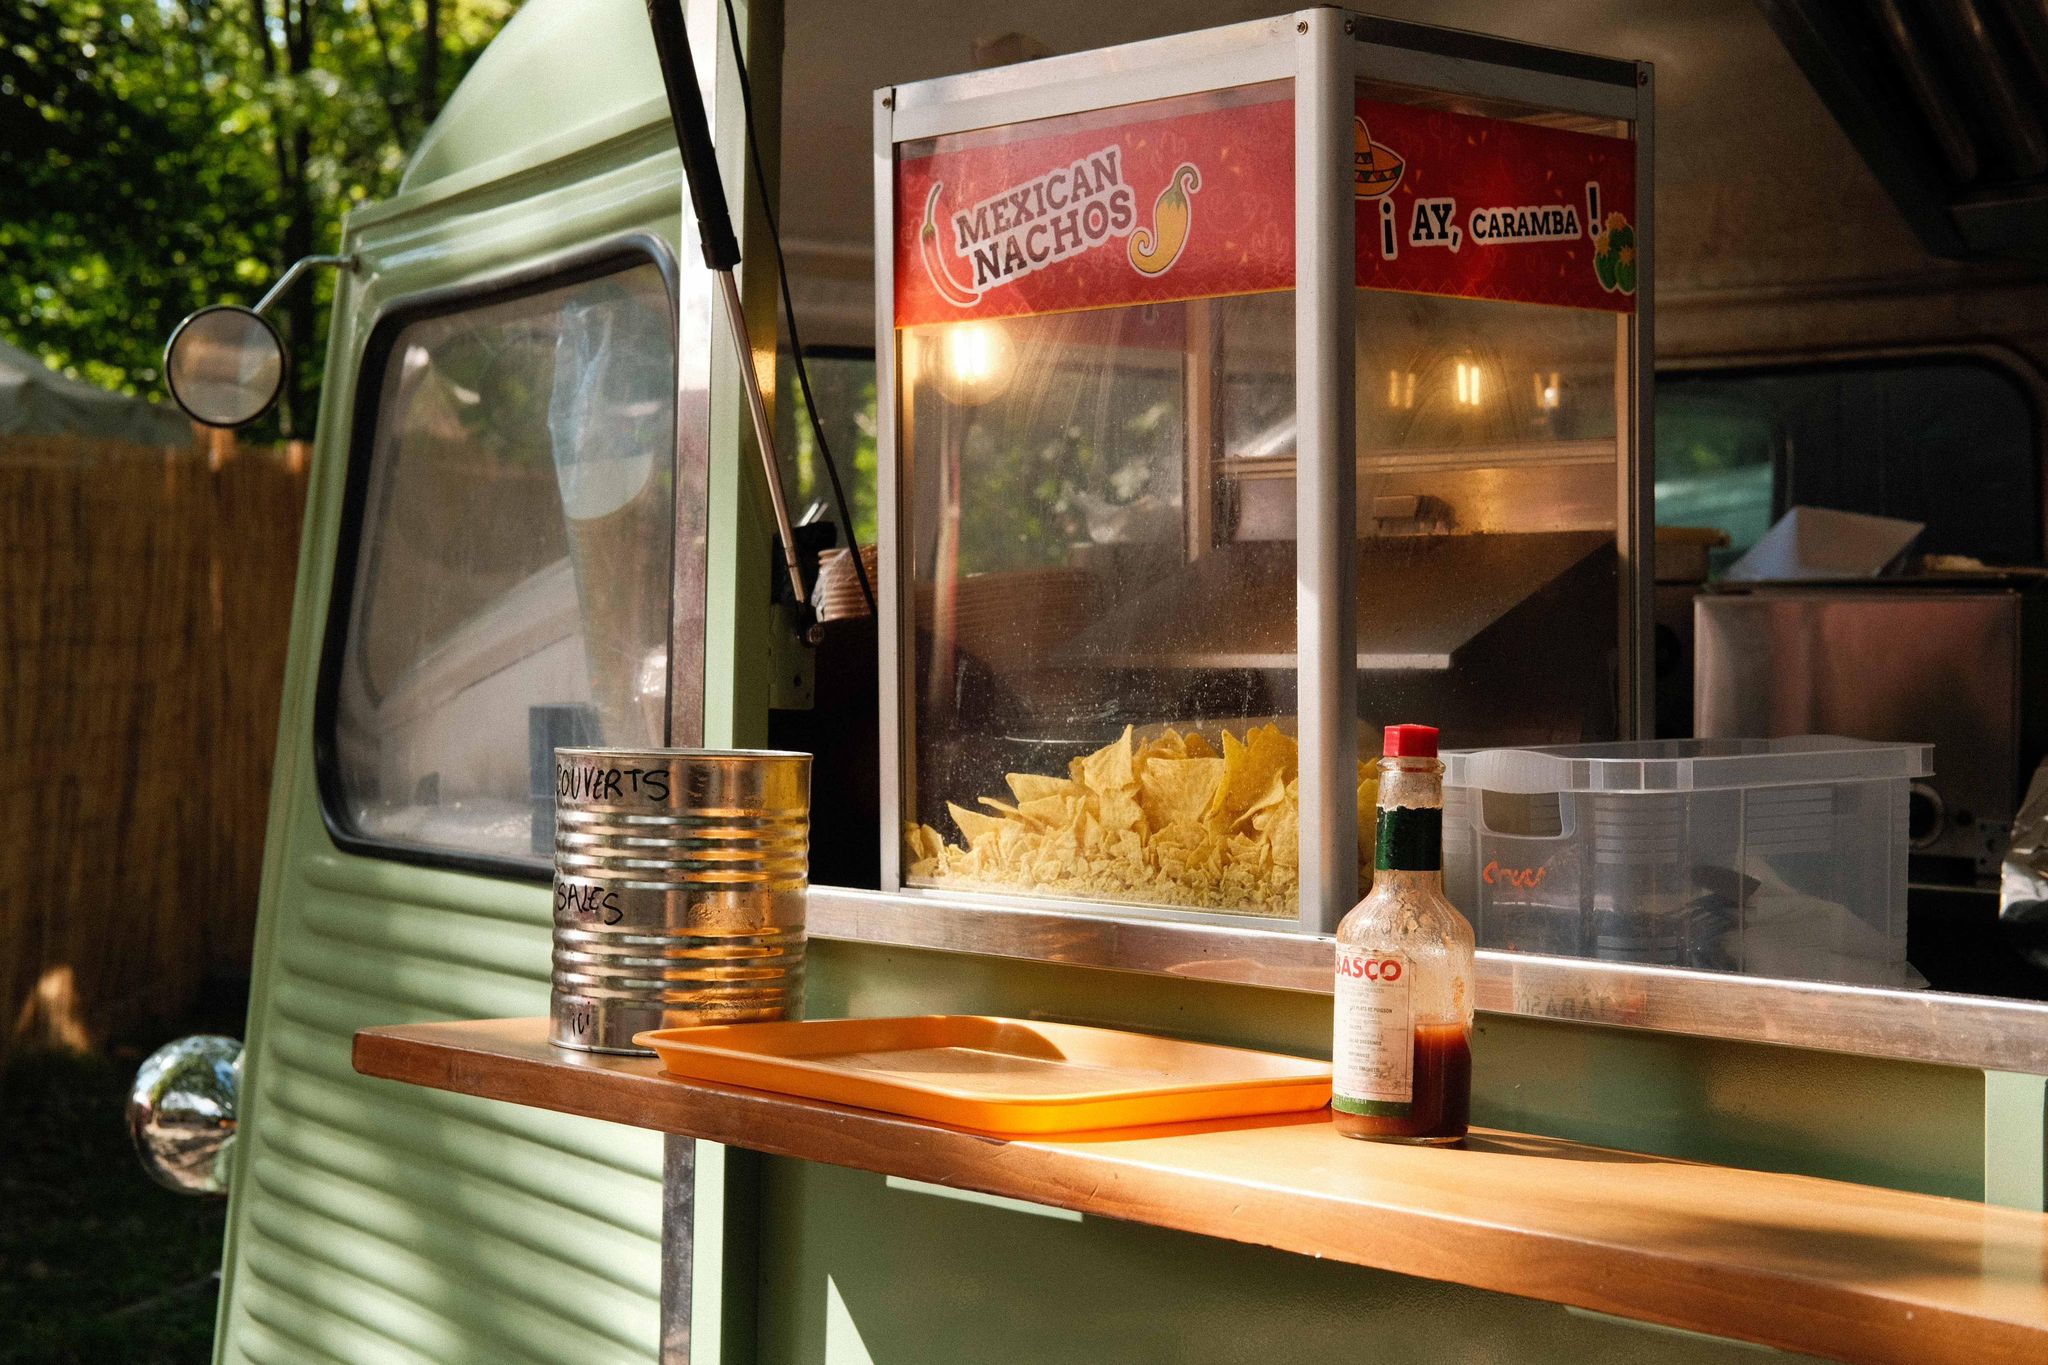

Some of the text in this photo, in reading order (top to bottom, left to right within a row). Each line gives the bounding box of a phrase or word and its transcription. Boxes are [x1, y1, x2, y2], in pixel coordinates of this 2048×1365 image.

[955, 150, 1119, 249] MEXICAN
[973, 189, 1133, 286] NACHOS
[1472, 210, 1578, 239] CARAMBA
[556, 763, 670, 801] COUVERTS
[556, 883, 624, 925] SALES
